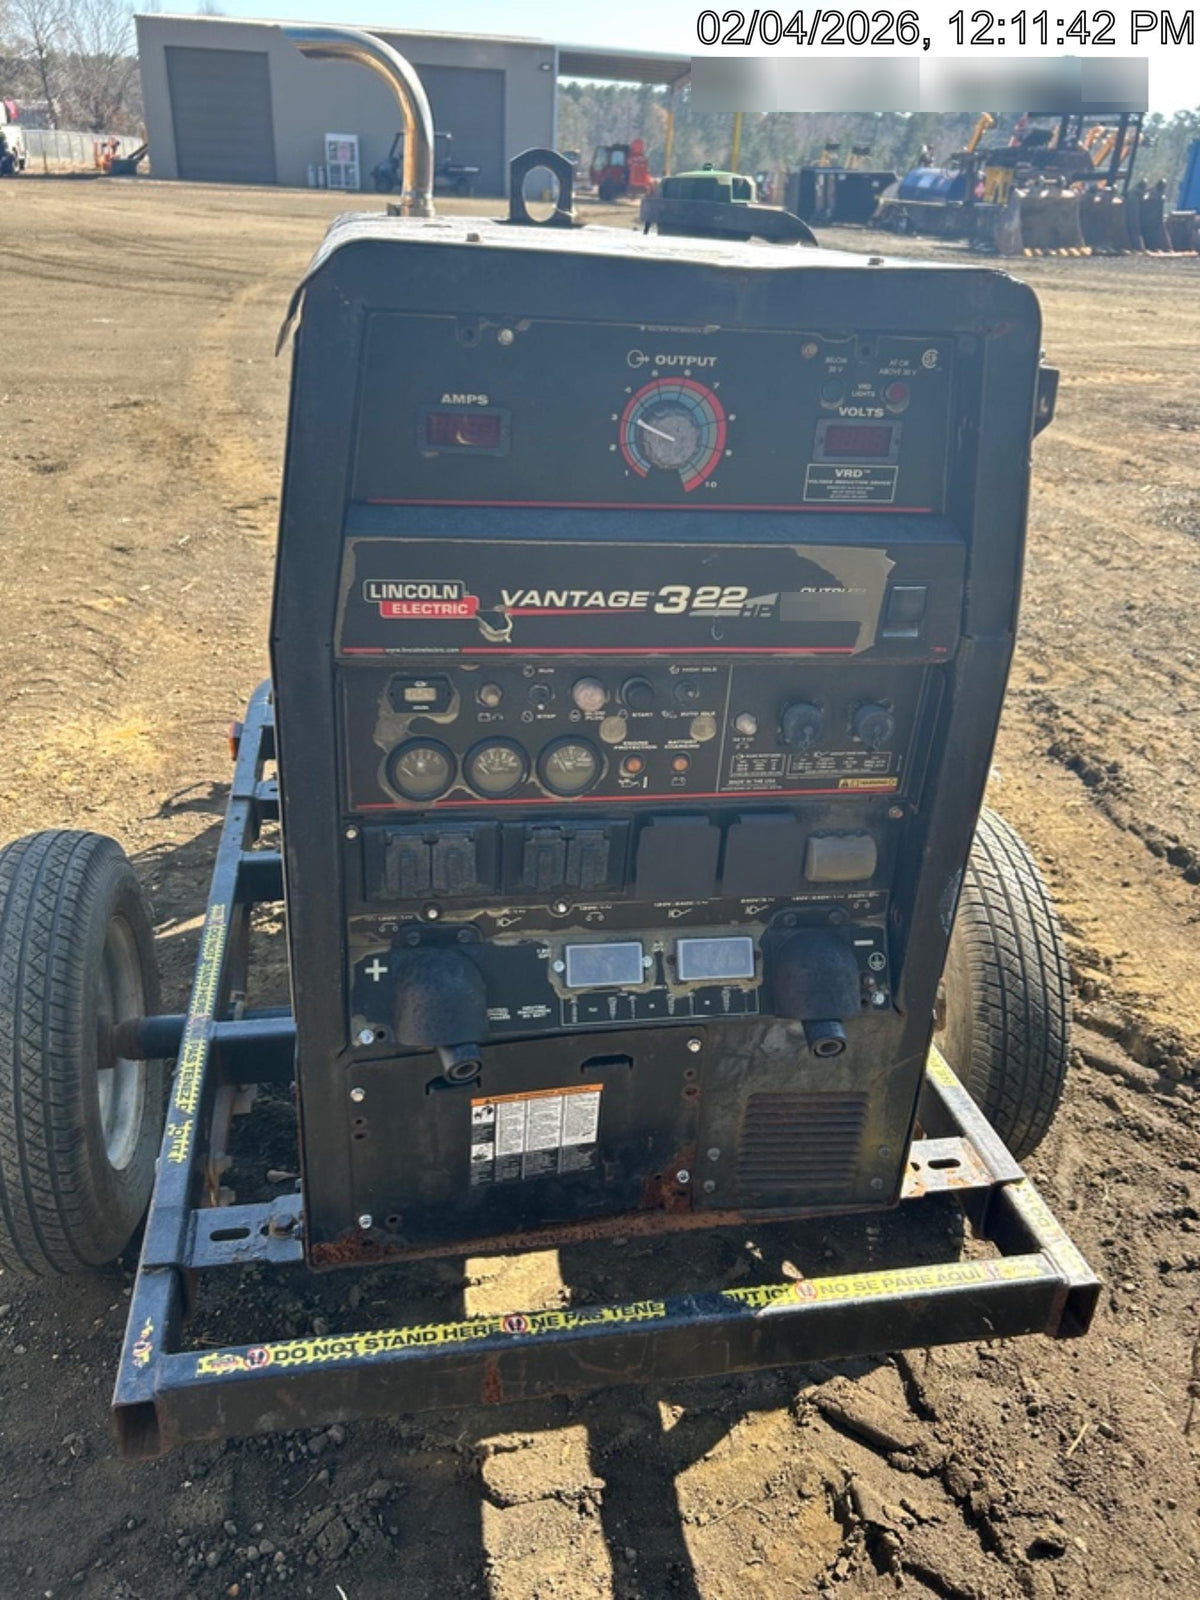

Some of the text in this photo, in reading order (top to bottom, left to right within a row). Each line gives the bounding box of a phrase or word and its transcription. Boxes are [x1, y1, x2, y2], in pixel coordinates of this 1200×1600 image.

[655, 354, 718, 368] OUTPUT
[441, 393, 489, 407] AMPS
[838, 406, 885, 418] VOLTS
[370, 584, 459, 600] LINCOLN
[501, 589, 650, 608] VANTAGE
[654, 585, 749, 615] 322
[391, 603, 469, 616] ELECTRIC
[178, 1065, 195, 1101] TENEZ
[820, 1283, 849, 1296] NO
[853, 1281, 878, 1293] SE
[883, 1275, 932, 1290] PARE
[531, 1315, 559, 1330] NE
[274, 1321, 500, 1361] DO NOT STAND HERE
